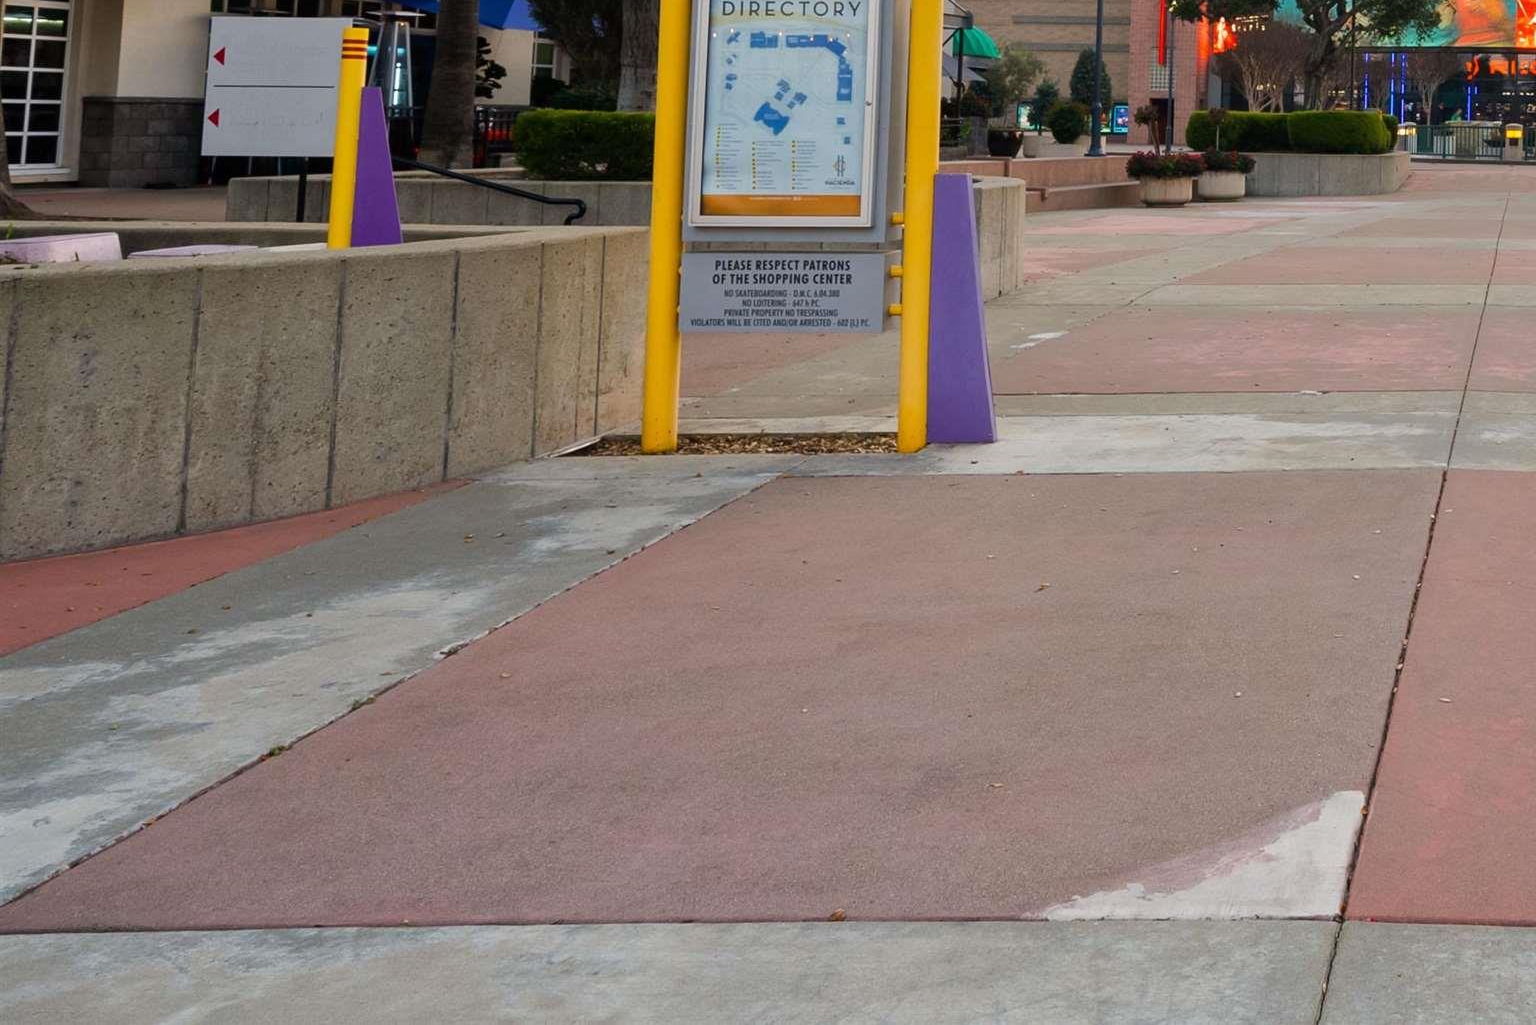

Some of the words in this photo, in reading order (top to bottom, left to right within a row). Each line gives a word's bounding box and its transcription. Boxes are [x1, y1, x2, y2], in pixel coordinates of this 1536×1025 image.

[722, 0, 861, 17] DIRECTORY
[715, 260, 751, 271] PLEASE
[755, 260, 799, 271] RESPECT
[803, 260, 850, 271] PATRONS
[712, 274, 726, 285] OF
[730, 274, 749, 285] THE
[753, 274, 809, 285] SHOPPING
[813, 274, 852, 285] CENTER
[735, 290, 787, 298] SKATEBOARDING
[724, 309, 750, 317] PRIVATE
[751, 309, 784, 317] PROPERTY
[785, 309, 795, 317] NO
[797, 309, 838, 317] TRESPASSING
[773, 319, 797, 327] AND/OR
